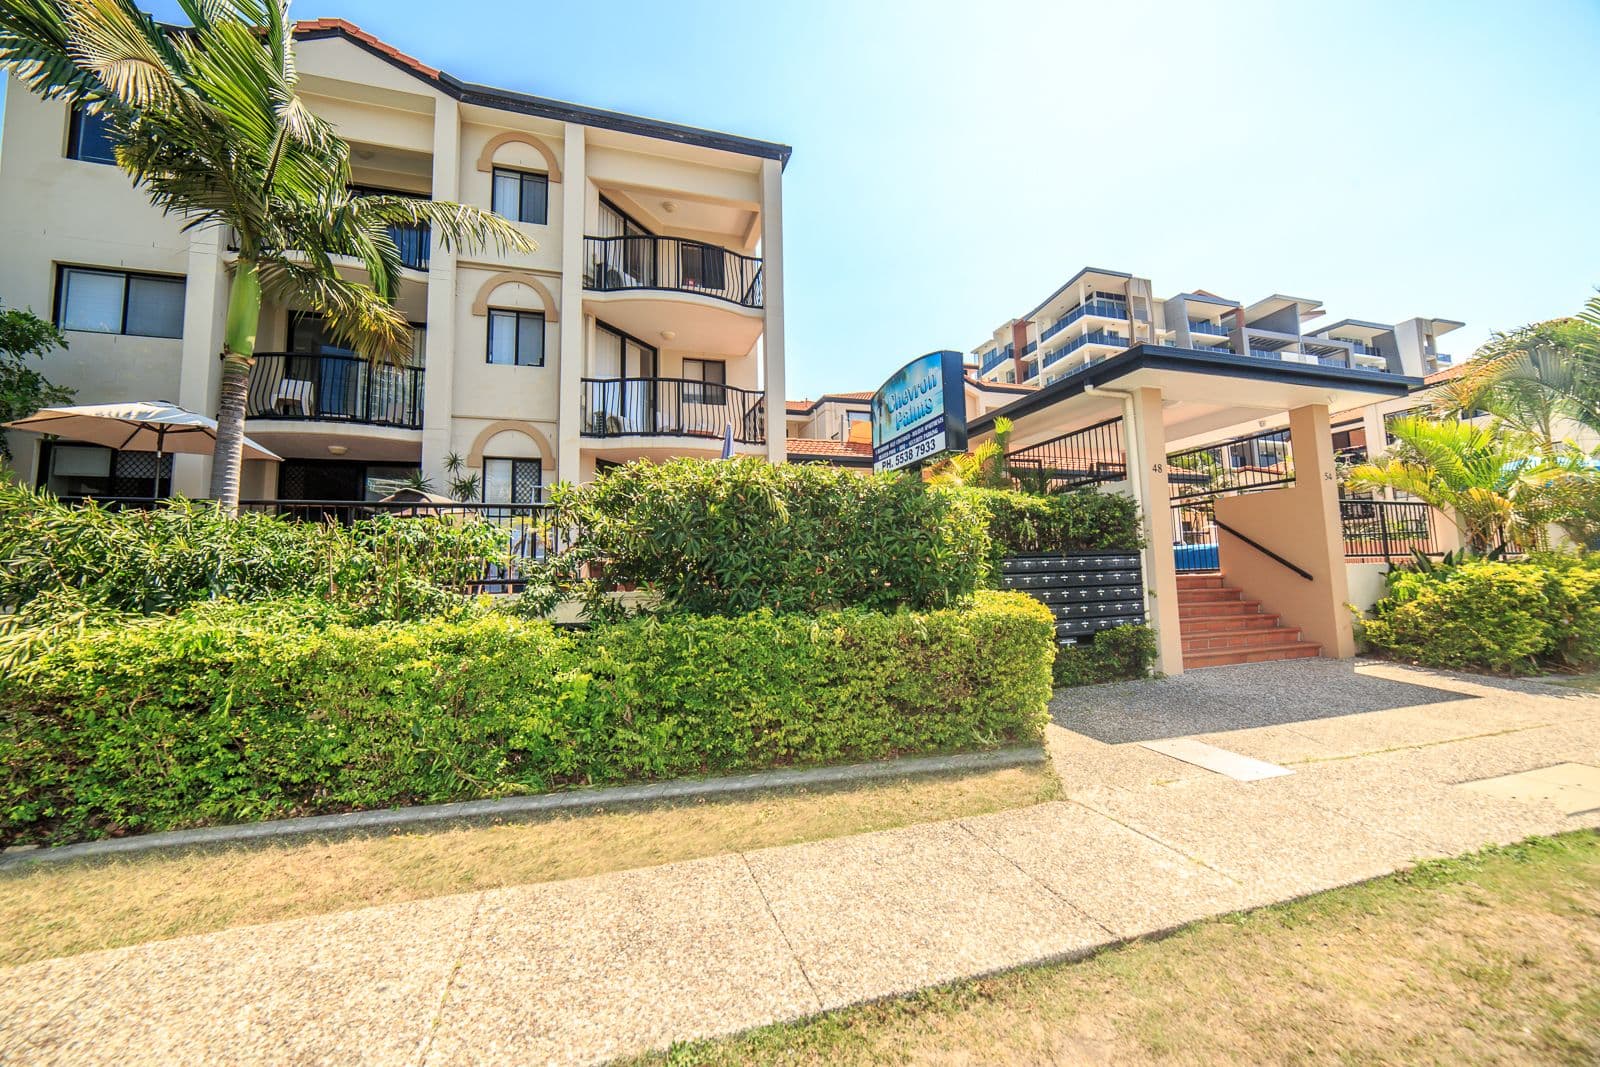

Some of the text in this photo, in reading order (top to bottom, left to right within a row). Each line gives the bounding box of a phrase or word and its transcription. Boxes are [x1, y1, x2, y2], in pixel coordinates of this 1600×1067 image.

[885, 373, 938, 413] Chevron
[895, 397, 934, 431] Palms
[895, 449, 914, 466] 5538
[915, 438, 936, 457] 7933
[1152, 463, 1162, 474] 48
